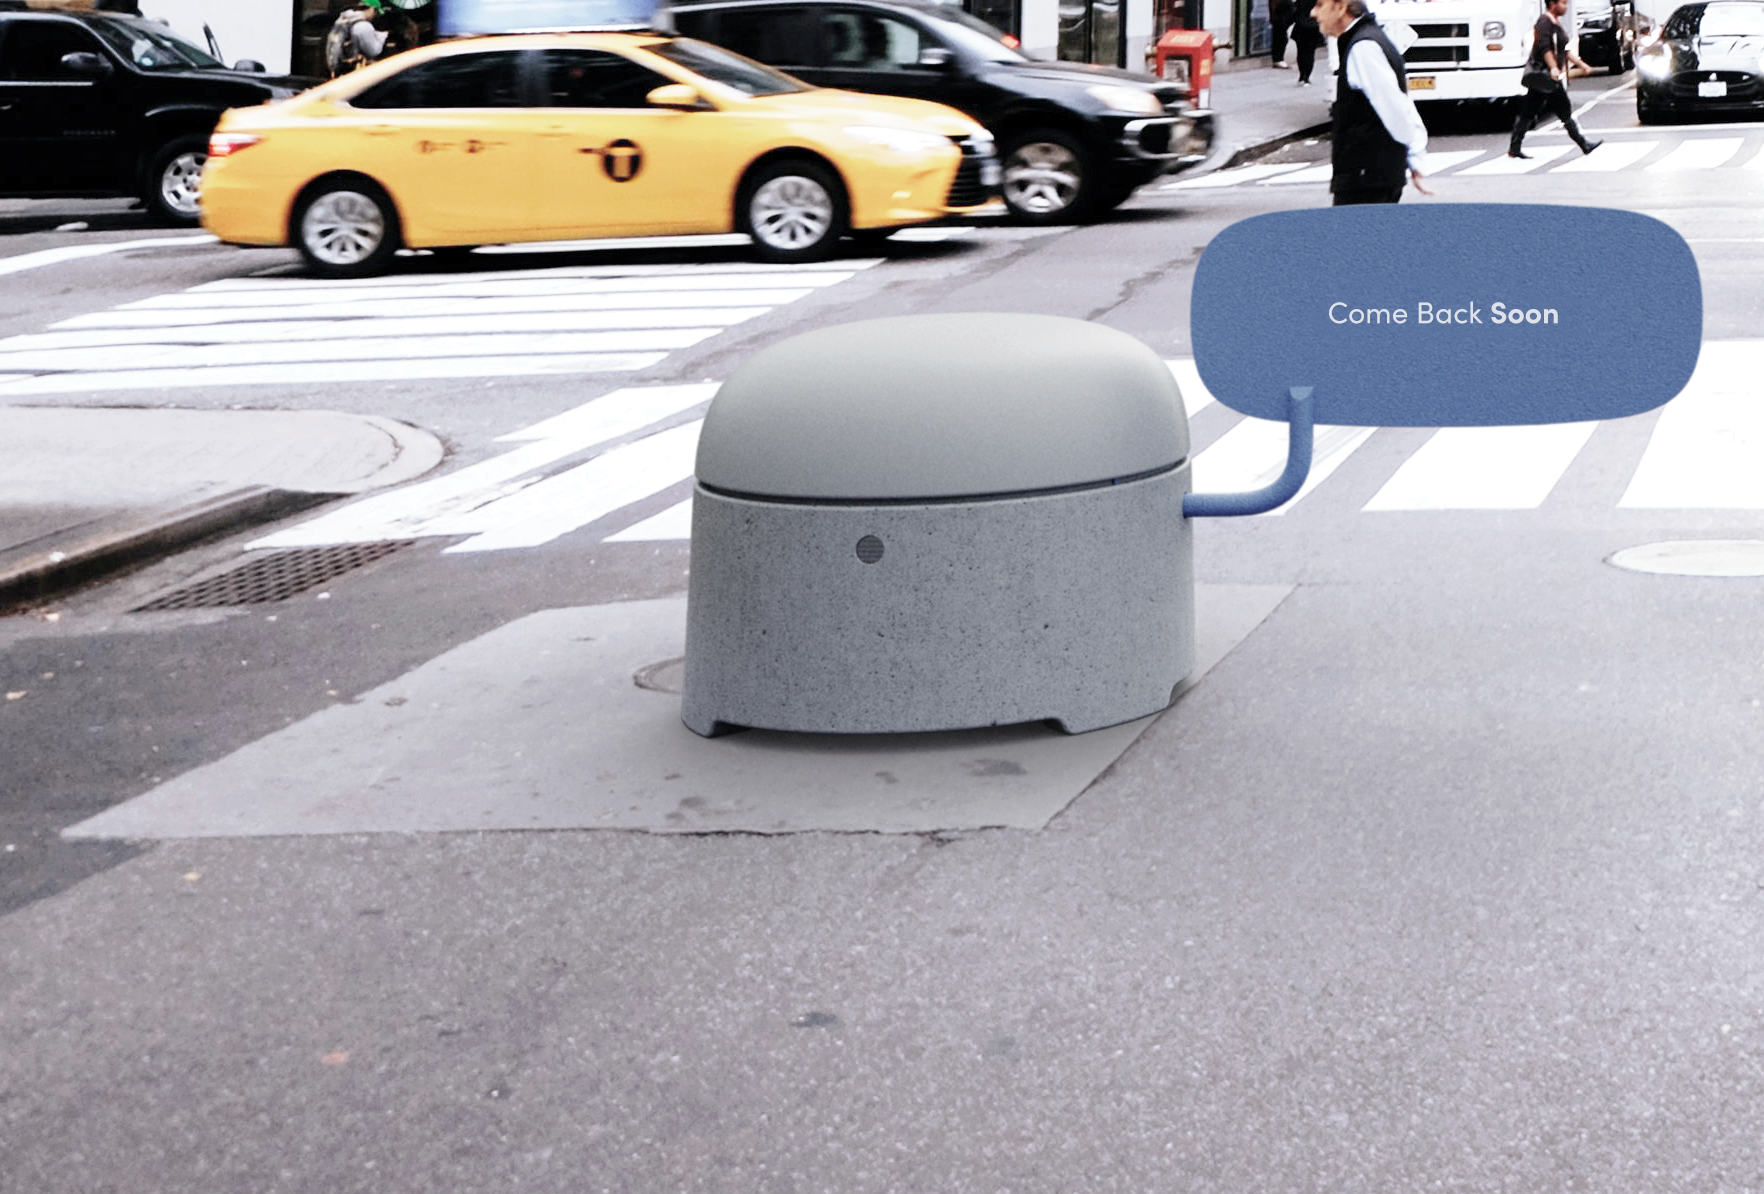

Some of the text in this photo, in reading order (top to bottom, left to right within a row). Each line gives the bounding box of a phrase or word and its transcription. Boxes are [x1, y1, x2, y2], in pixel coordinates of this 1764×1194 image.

[1328, 301, 1559, 324] Come Back Soon
